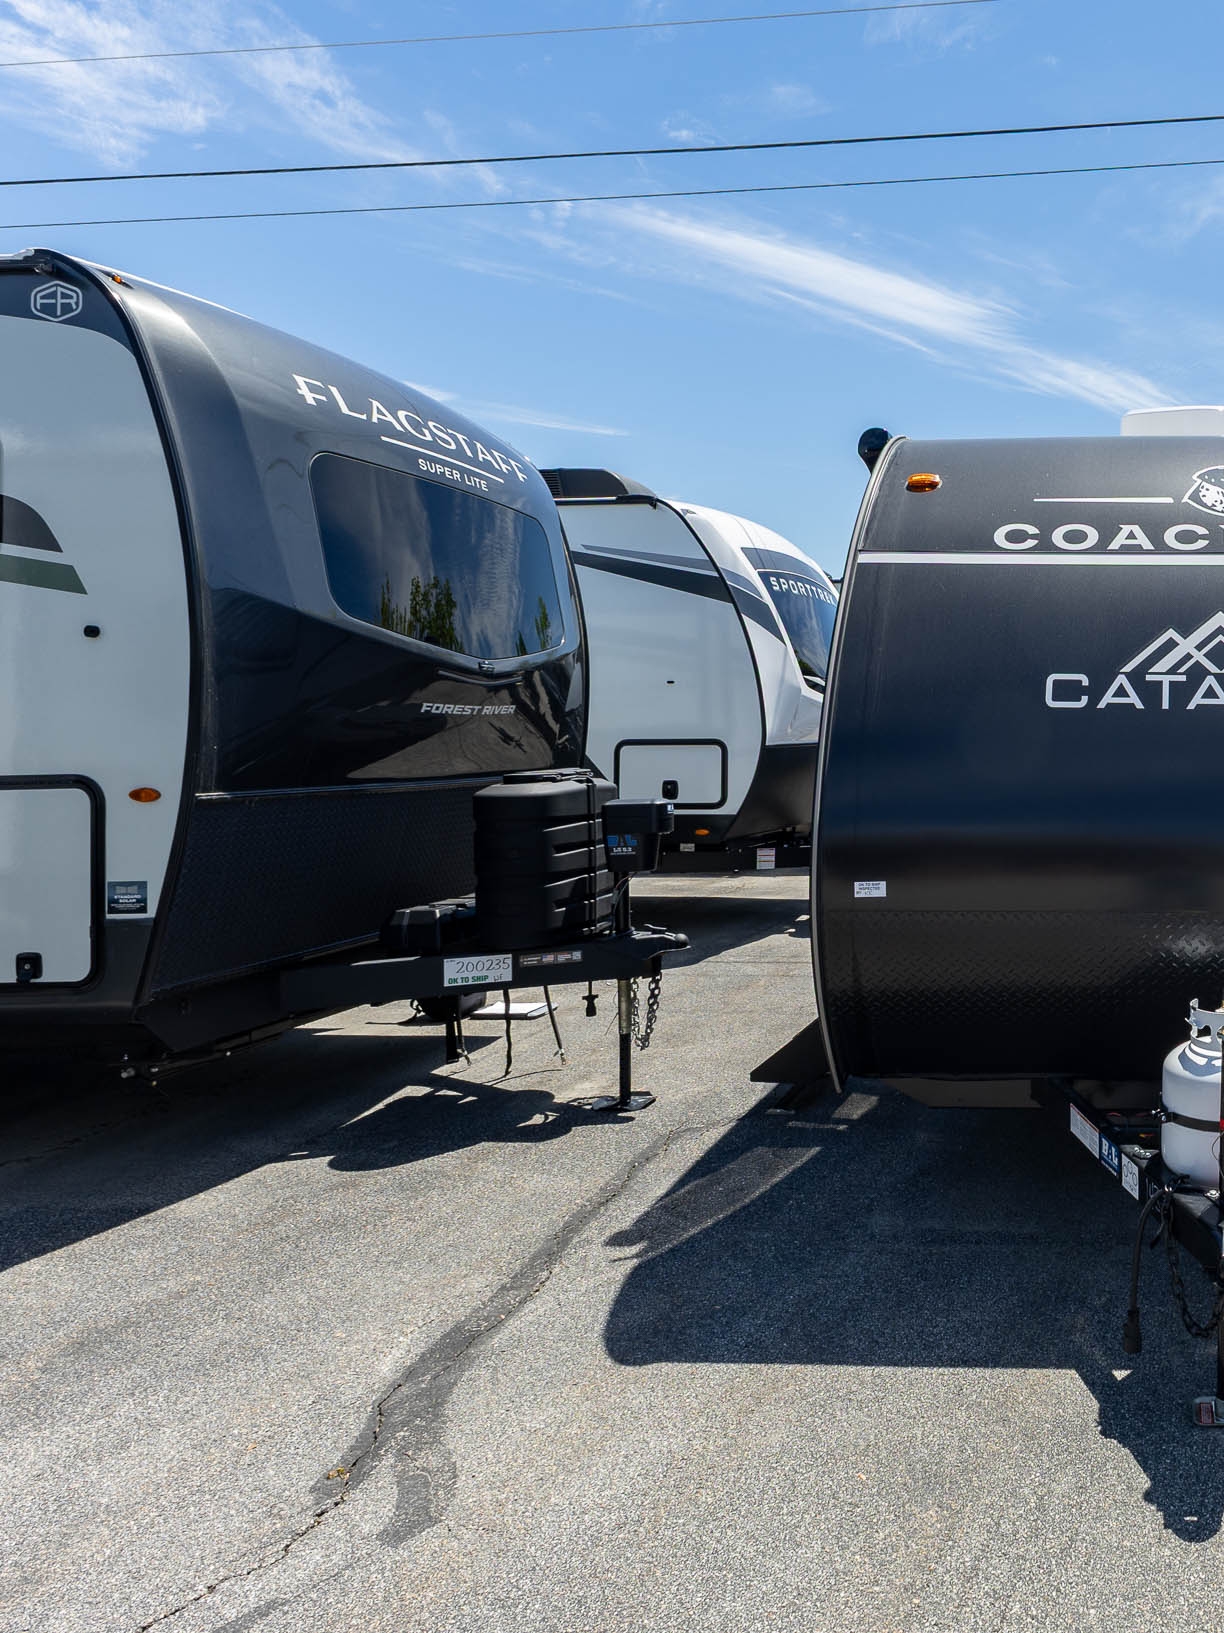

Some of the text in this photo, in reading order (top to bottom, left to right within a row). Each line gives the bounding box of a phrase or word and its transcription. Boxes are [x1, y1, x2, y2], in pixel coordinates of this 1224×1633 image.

[292, 373, 528, 483] FLAGSTAFF
[418, 458, 489, 492] SUPER LITE
[420, 702, 517, 715] FOREST RIVER
[455, 957, 511, 974] 200235
[447, 975, 489, 985] OK TO SHIP
